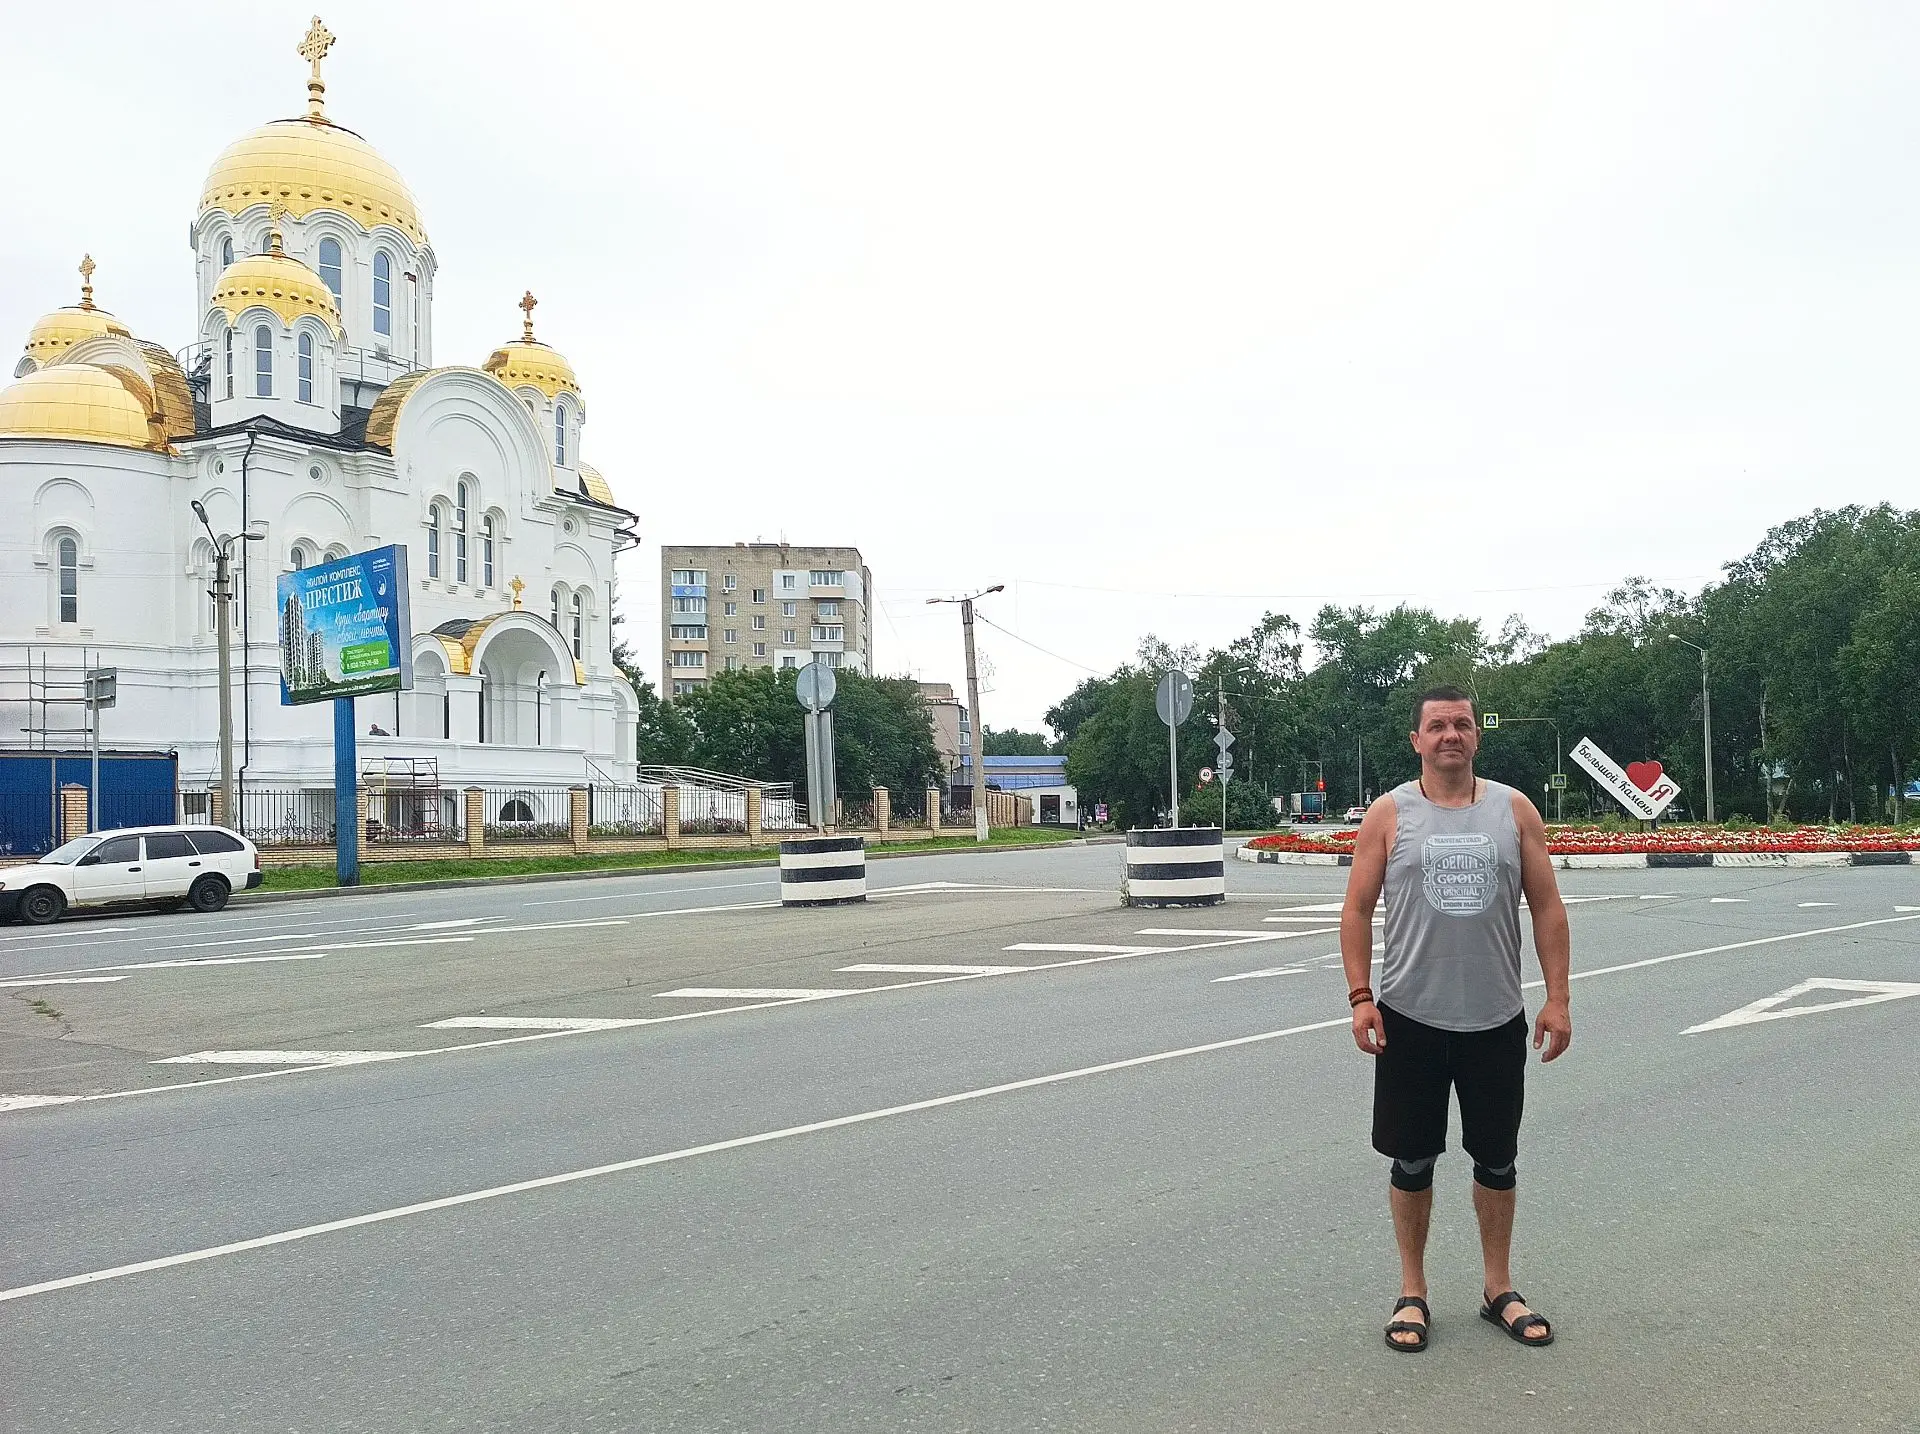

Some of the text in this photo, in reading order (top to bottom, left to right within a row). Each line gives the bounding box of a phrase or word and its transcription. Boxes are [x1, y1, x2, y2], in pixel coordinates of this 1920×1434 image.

[329, 565, 361, 583] КОМПЛЕКС
[305, 578, 363, 610] ПРЕСТИЖ
[1577, 744, 1653, 816] Большой Камень
[1648, 784, 1674, 802] Я
[1442, 855, 1478, 870] DENIM
[1437, 873, 1485, 884] GOODS
[1443, 886, 1480, 897] ORIGINAL
